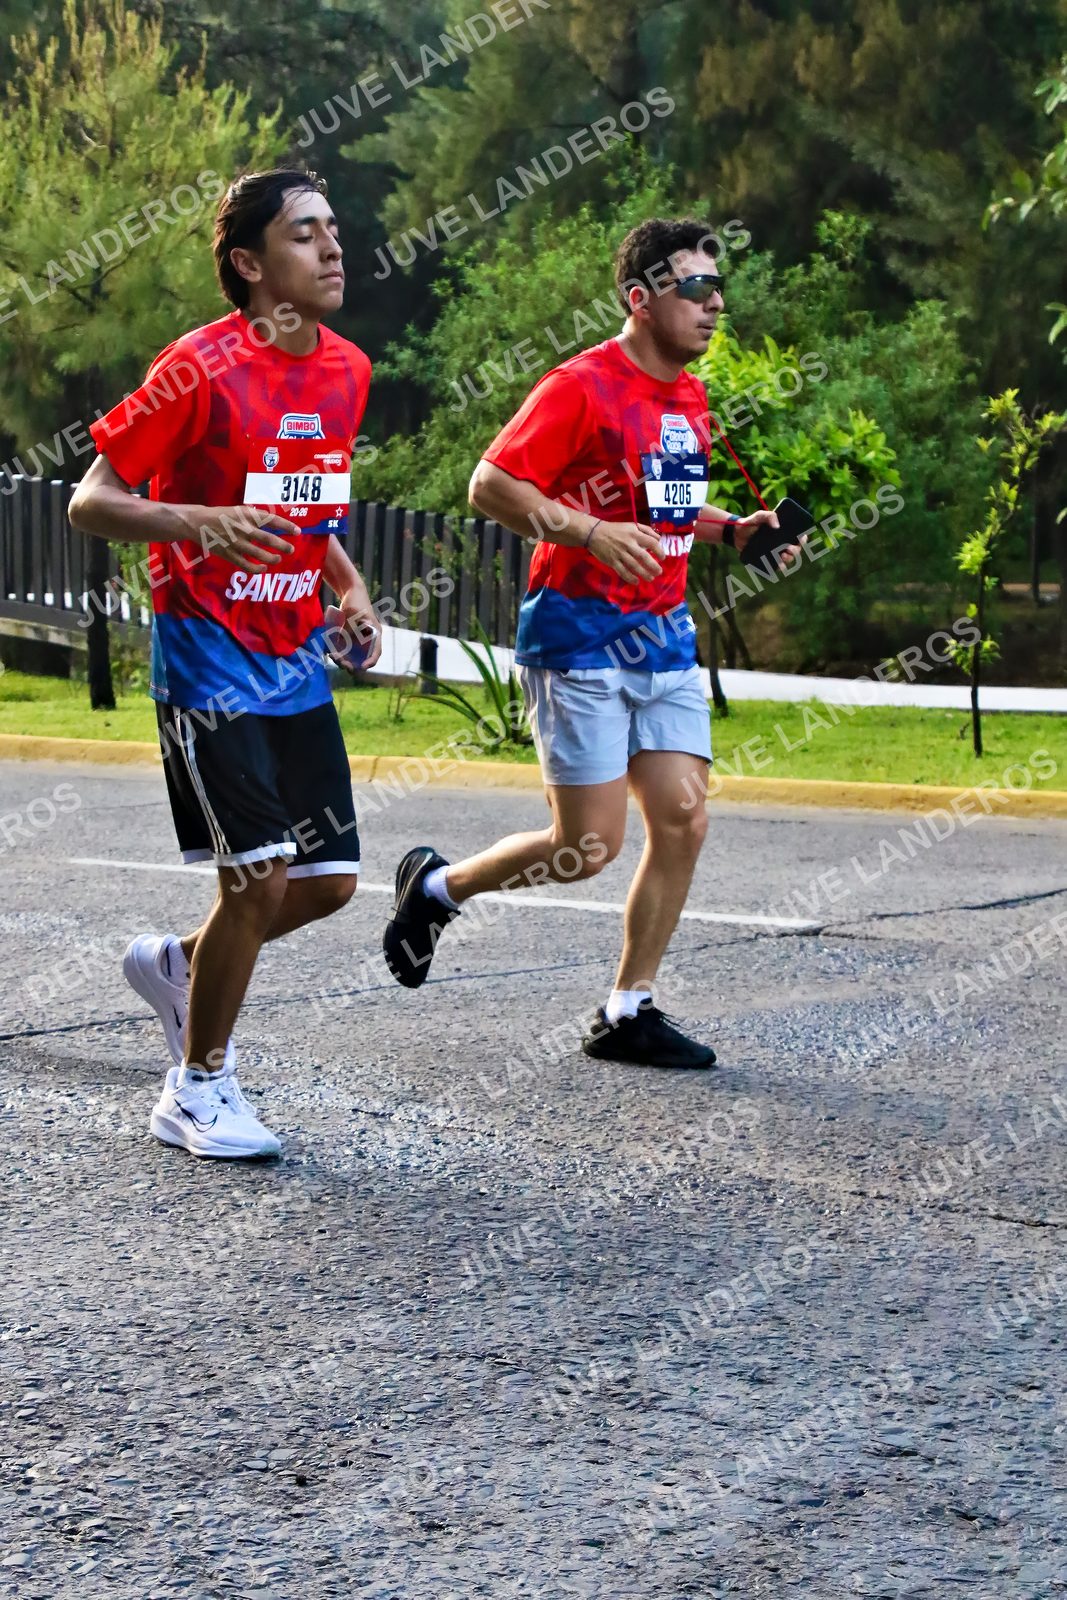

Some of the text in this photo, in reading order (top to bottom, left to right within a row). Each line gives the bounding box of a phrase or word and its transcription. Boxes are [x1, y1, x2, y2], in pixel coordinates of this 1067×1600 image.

[286, 420, 316, 431] BIMBO
[281, 475, 322, 502] 3148
[664, 483, 692, 505] 4205
[327, 519, 339, 528] 5K
